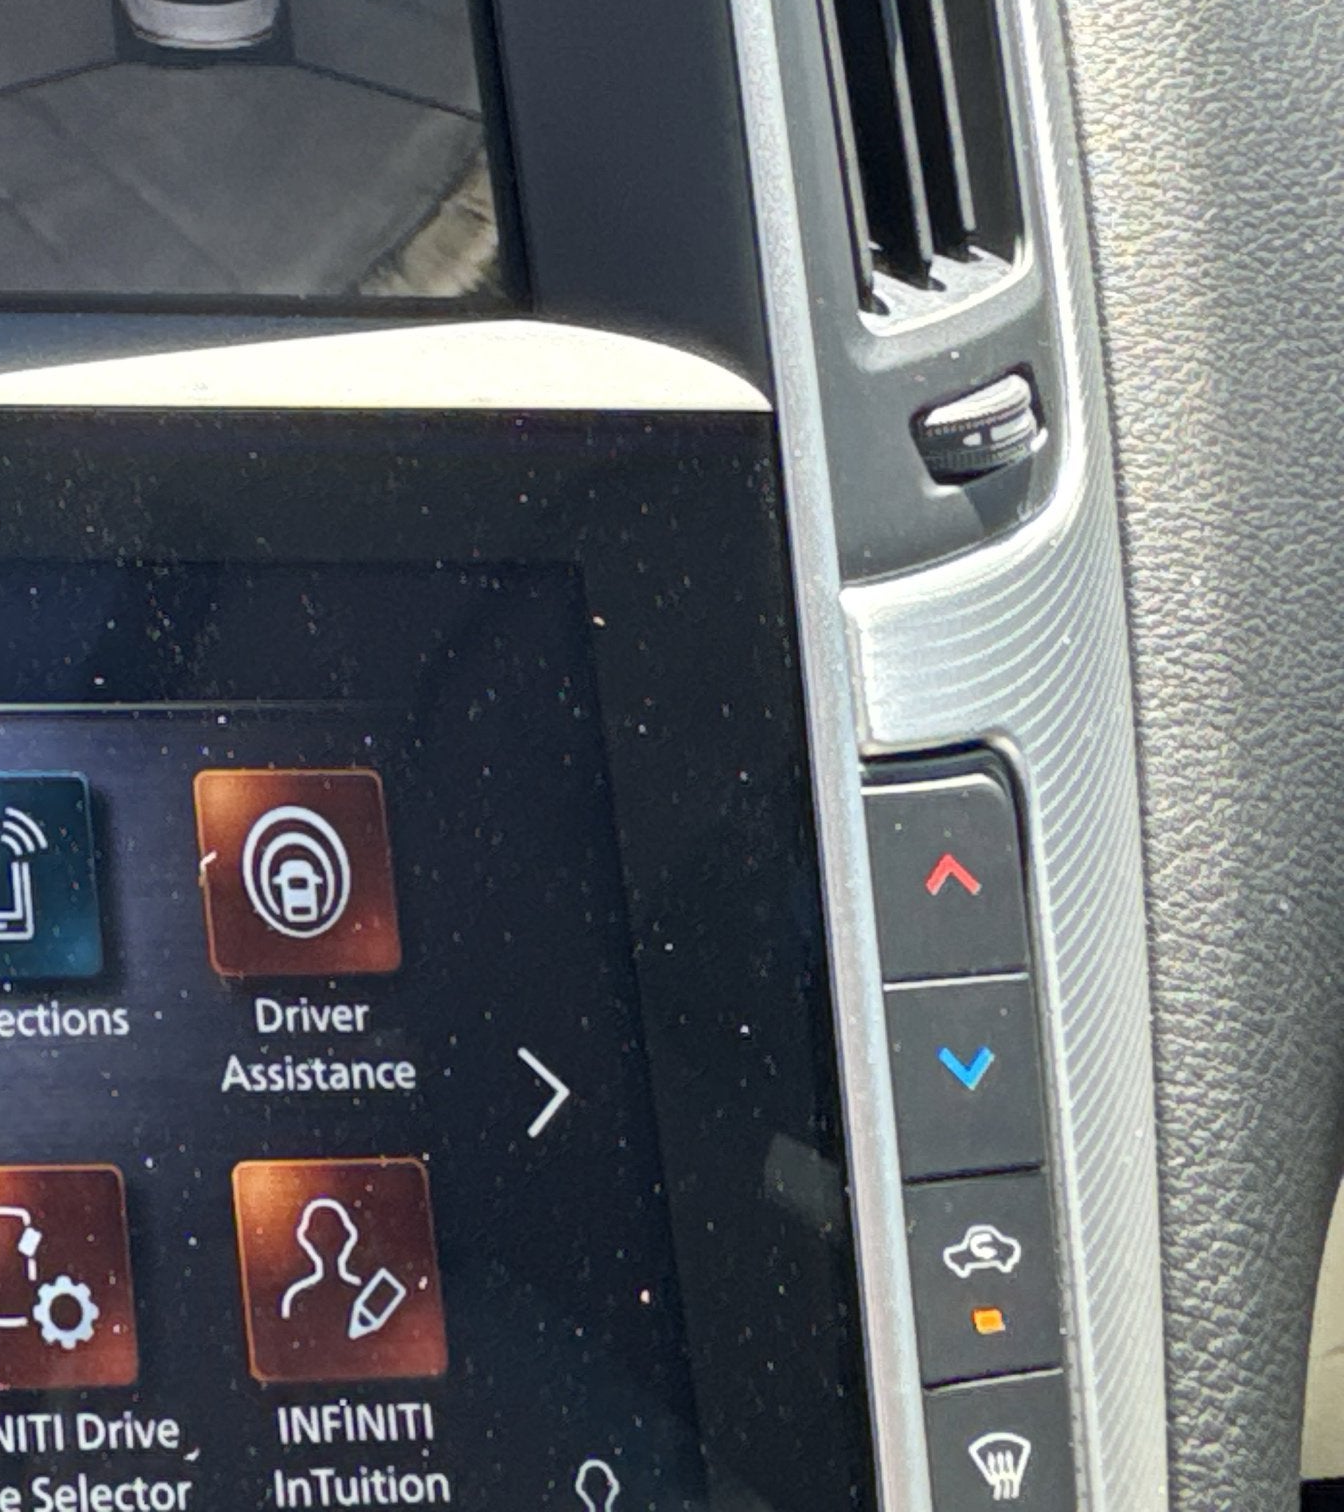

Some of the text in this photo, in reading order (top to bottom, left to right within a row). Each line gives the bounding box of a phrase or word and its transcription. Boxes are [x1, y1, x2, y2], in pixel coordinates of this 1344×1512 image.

[254, 999, 370, 1034] Driver
[221, 1056, 417, 1093] Assistance
[76, 1413, 181, 1450] Drive
[277, 1403, 434, 1445] INFINITI
[31, 1474, 192, 1512] Selector
[274, 1468, 451, 1508] InTuition
